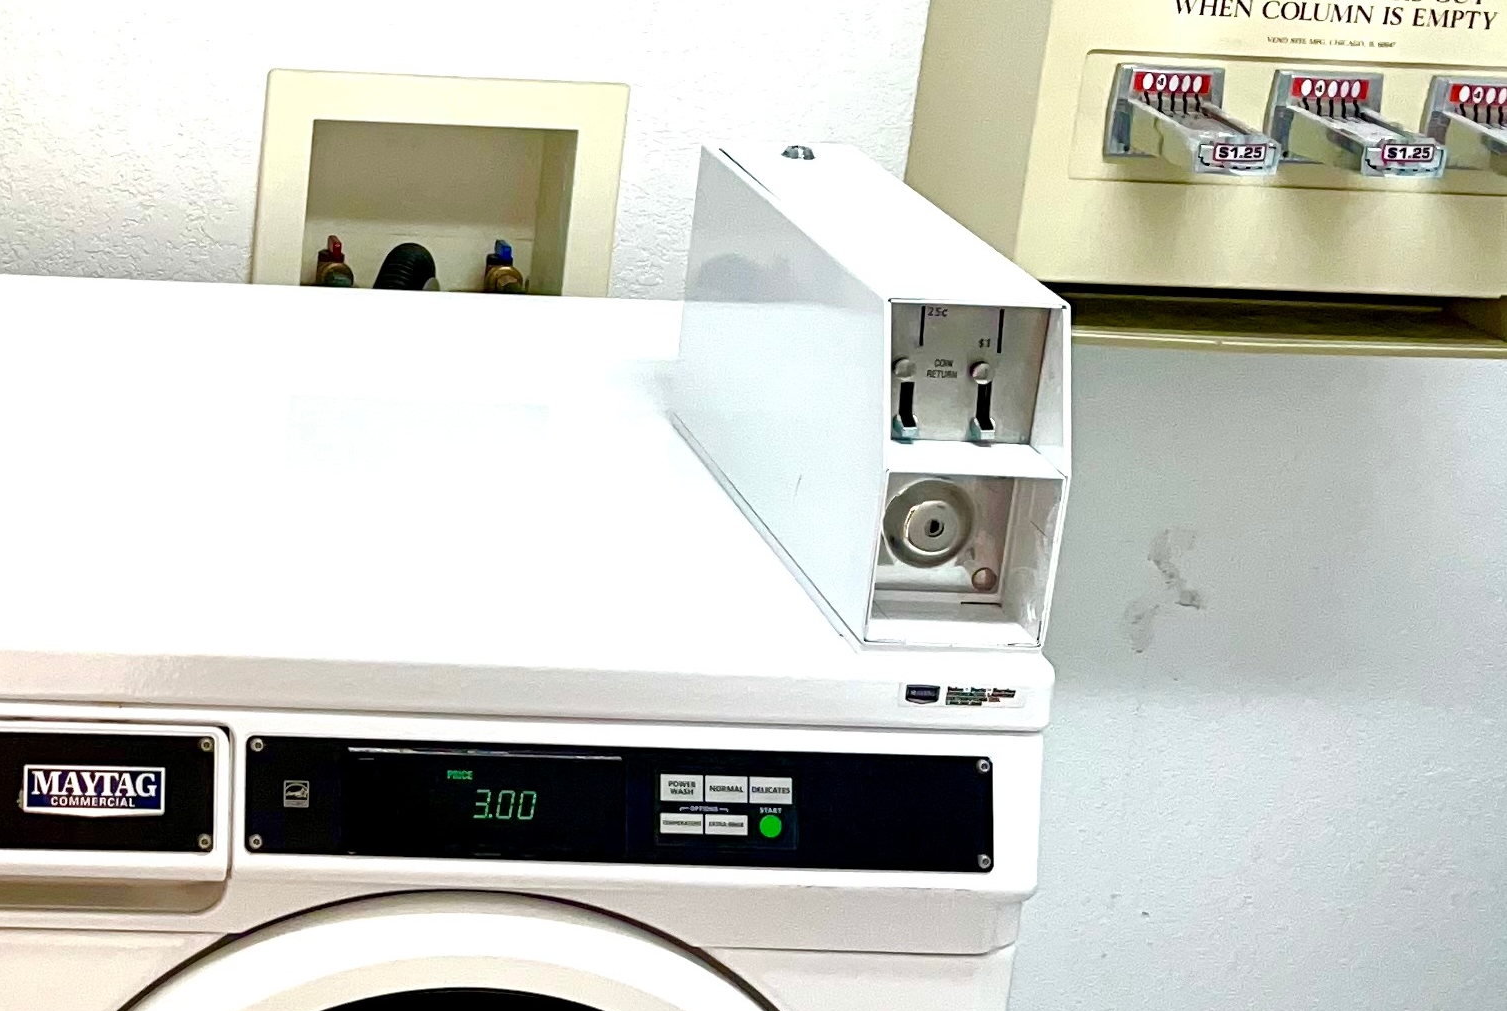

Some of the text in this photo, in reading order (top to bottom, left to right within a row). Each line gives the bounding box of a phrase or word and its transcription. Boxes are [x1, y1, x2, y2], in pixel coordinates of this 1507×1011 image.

[1175, 0, 1499, 30] WHEN COLUMN IS EMPTY
[934, 358, 954, 368] COIN
[926, 369, 958, 379] RETURN
[446, 770, 473, 780] PRICE
[31, 770, 157, 797] MAYTAG
[668, 780, 696, 788] POWER
[709, 785, 744, 793] NORMAL
[751, 786, 790, 794] DELICATES
[50, 796, 136, 808] COMMERCIAL
[473, 789, 537, 820] 3.00
